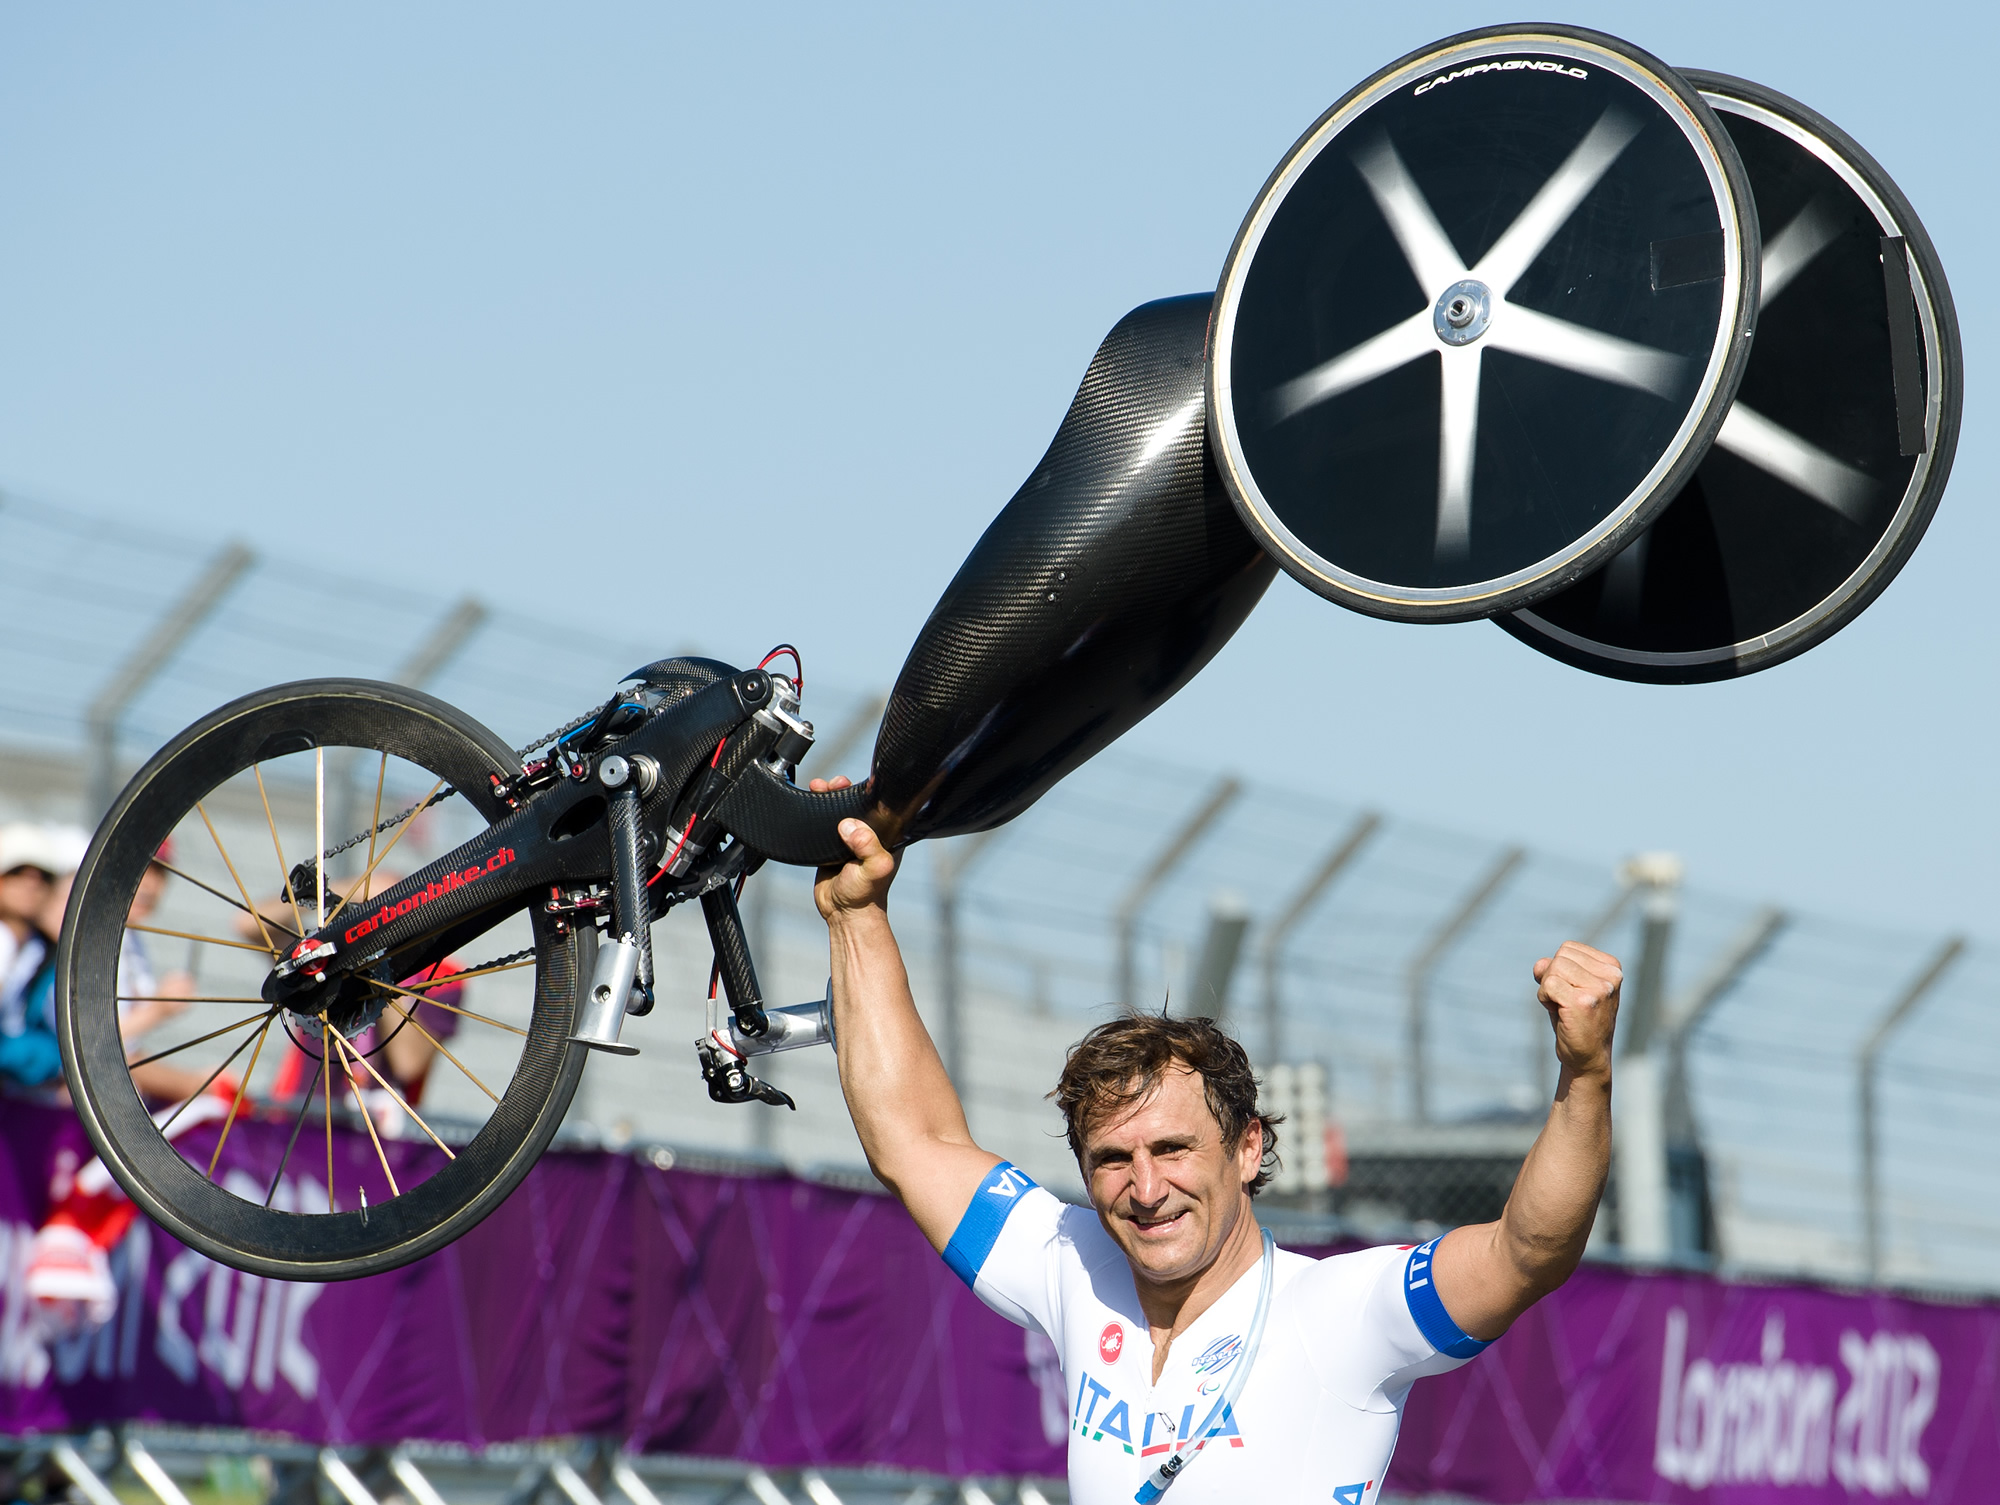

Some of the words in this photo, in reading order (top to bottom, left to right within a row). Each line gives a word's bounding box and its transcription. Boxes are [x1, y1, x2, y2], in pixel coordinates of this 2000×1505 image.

[1413, 60, 1589, 96] CAMPAGNOLO
[345, 847, 516, 944] carbonbike.ch
[1191, 1346, 1244, 1367] ITALIA
[1072, 1371, 1245, 1458] ITALIA
